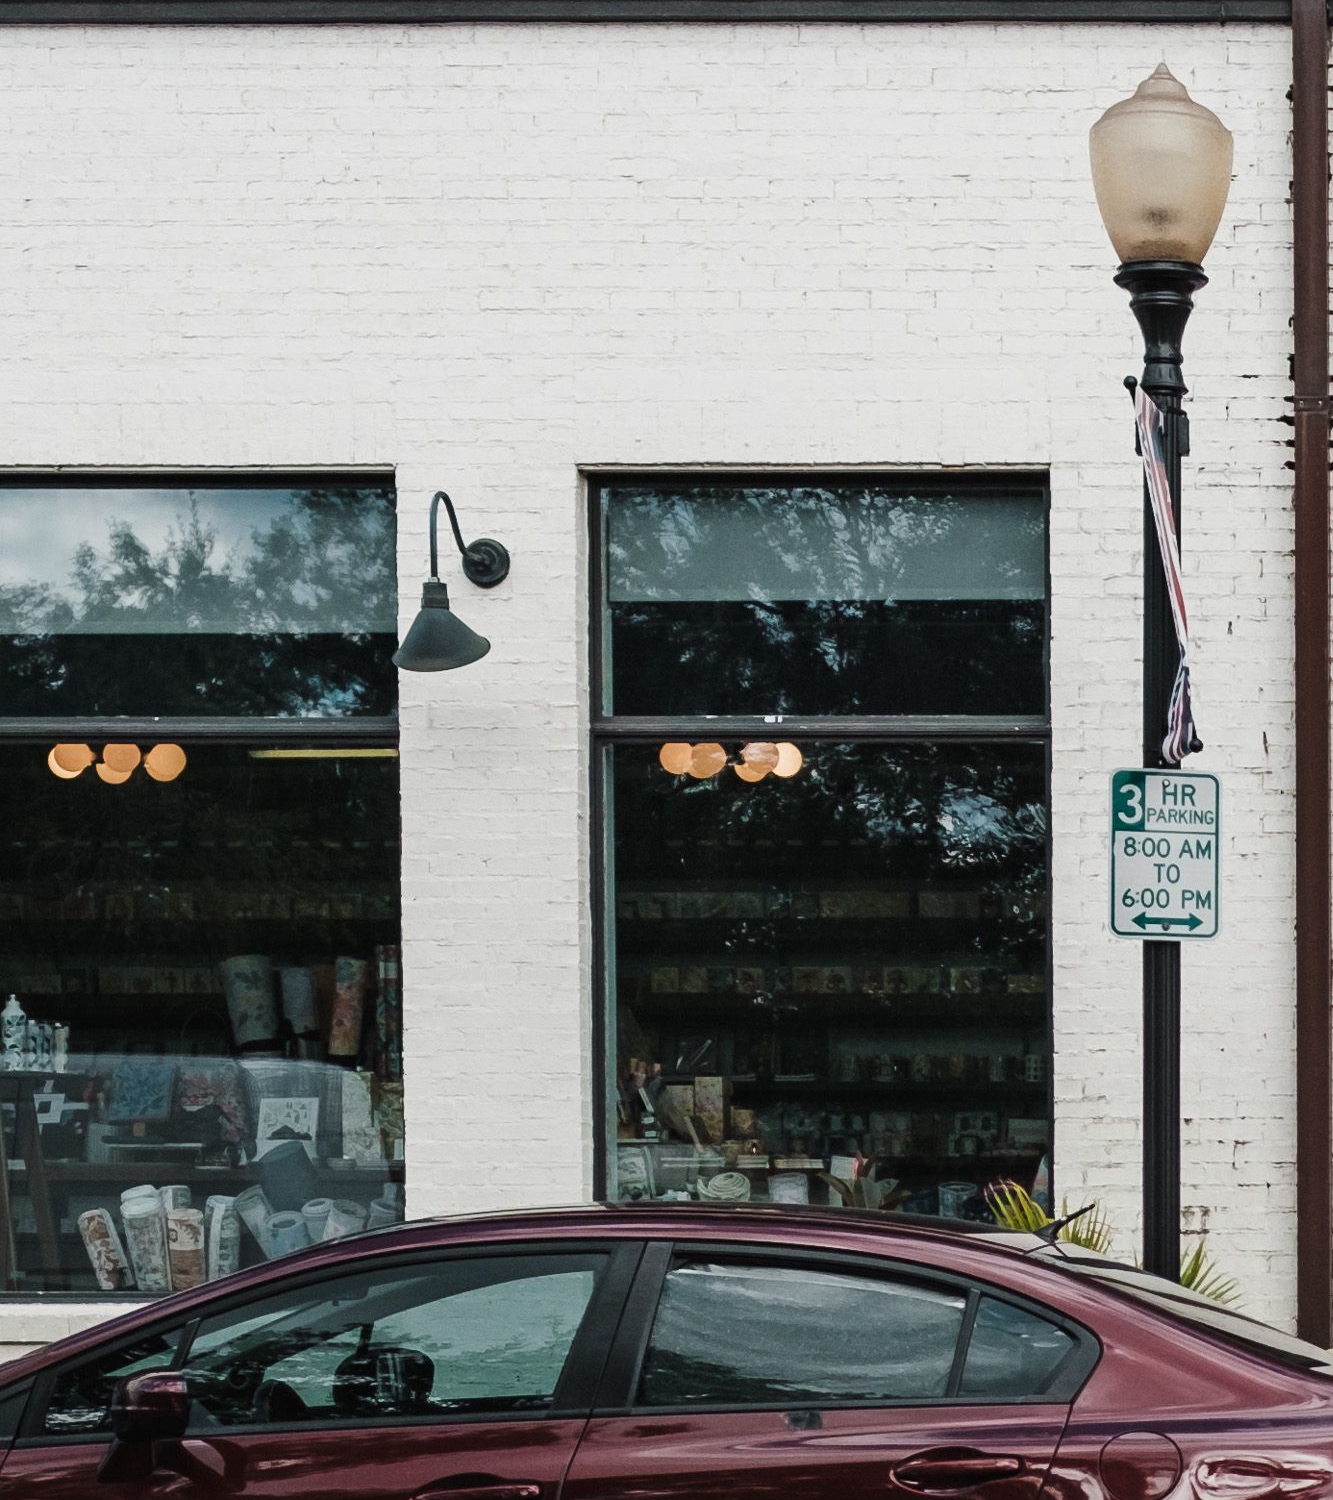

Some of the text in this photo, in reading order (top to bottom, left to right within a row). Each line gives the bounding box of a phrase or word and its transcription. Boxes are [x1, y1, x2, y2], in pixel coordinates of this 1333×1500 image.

[1117, 782, 1197, 824] 3 HR
[1146, 808, 1215, 826] PARKING
[1123, 836, 1212, 860] 8:00 AM
[1153, 863, 1181, 884] TO
[1121, 888, 1212, 910] 6:00 PM
